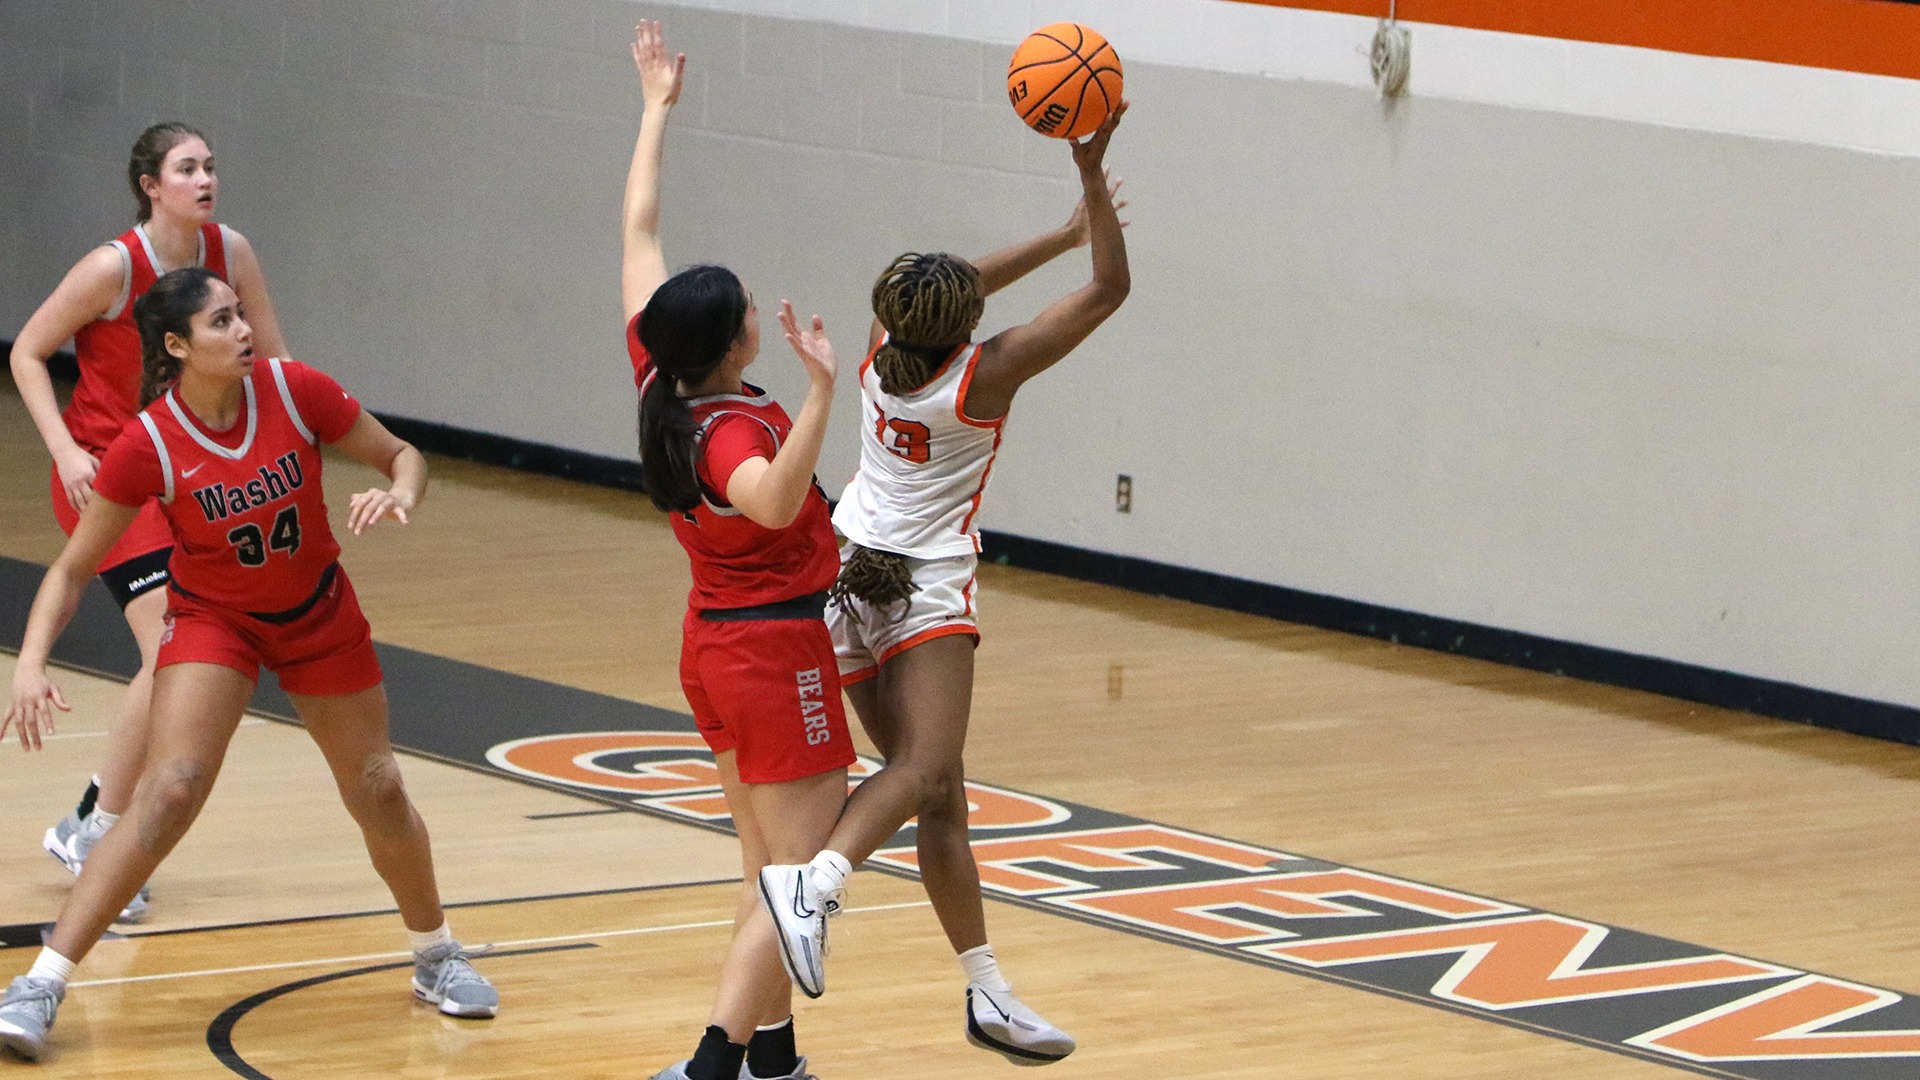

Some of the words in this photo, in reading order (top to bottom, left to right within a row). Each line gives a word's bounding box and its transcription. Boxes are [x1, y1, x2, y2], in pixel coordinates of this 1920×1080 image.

[191, 450, 304, 523] WashU
[226, 503, 302, 568] 34
[796, 667, 831, 746] BEARS
